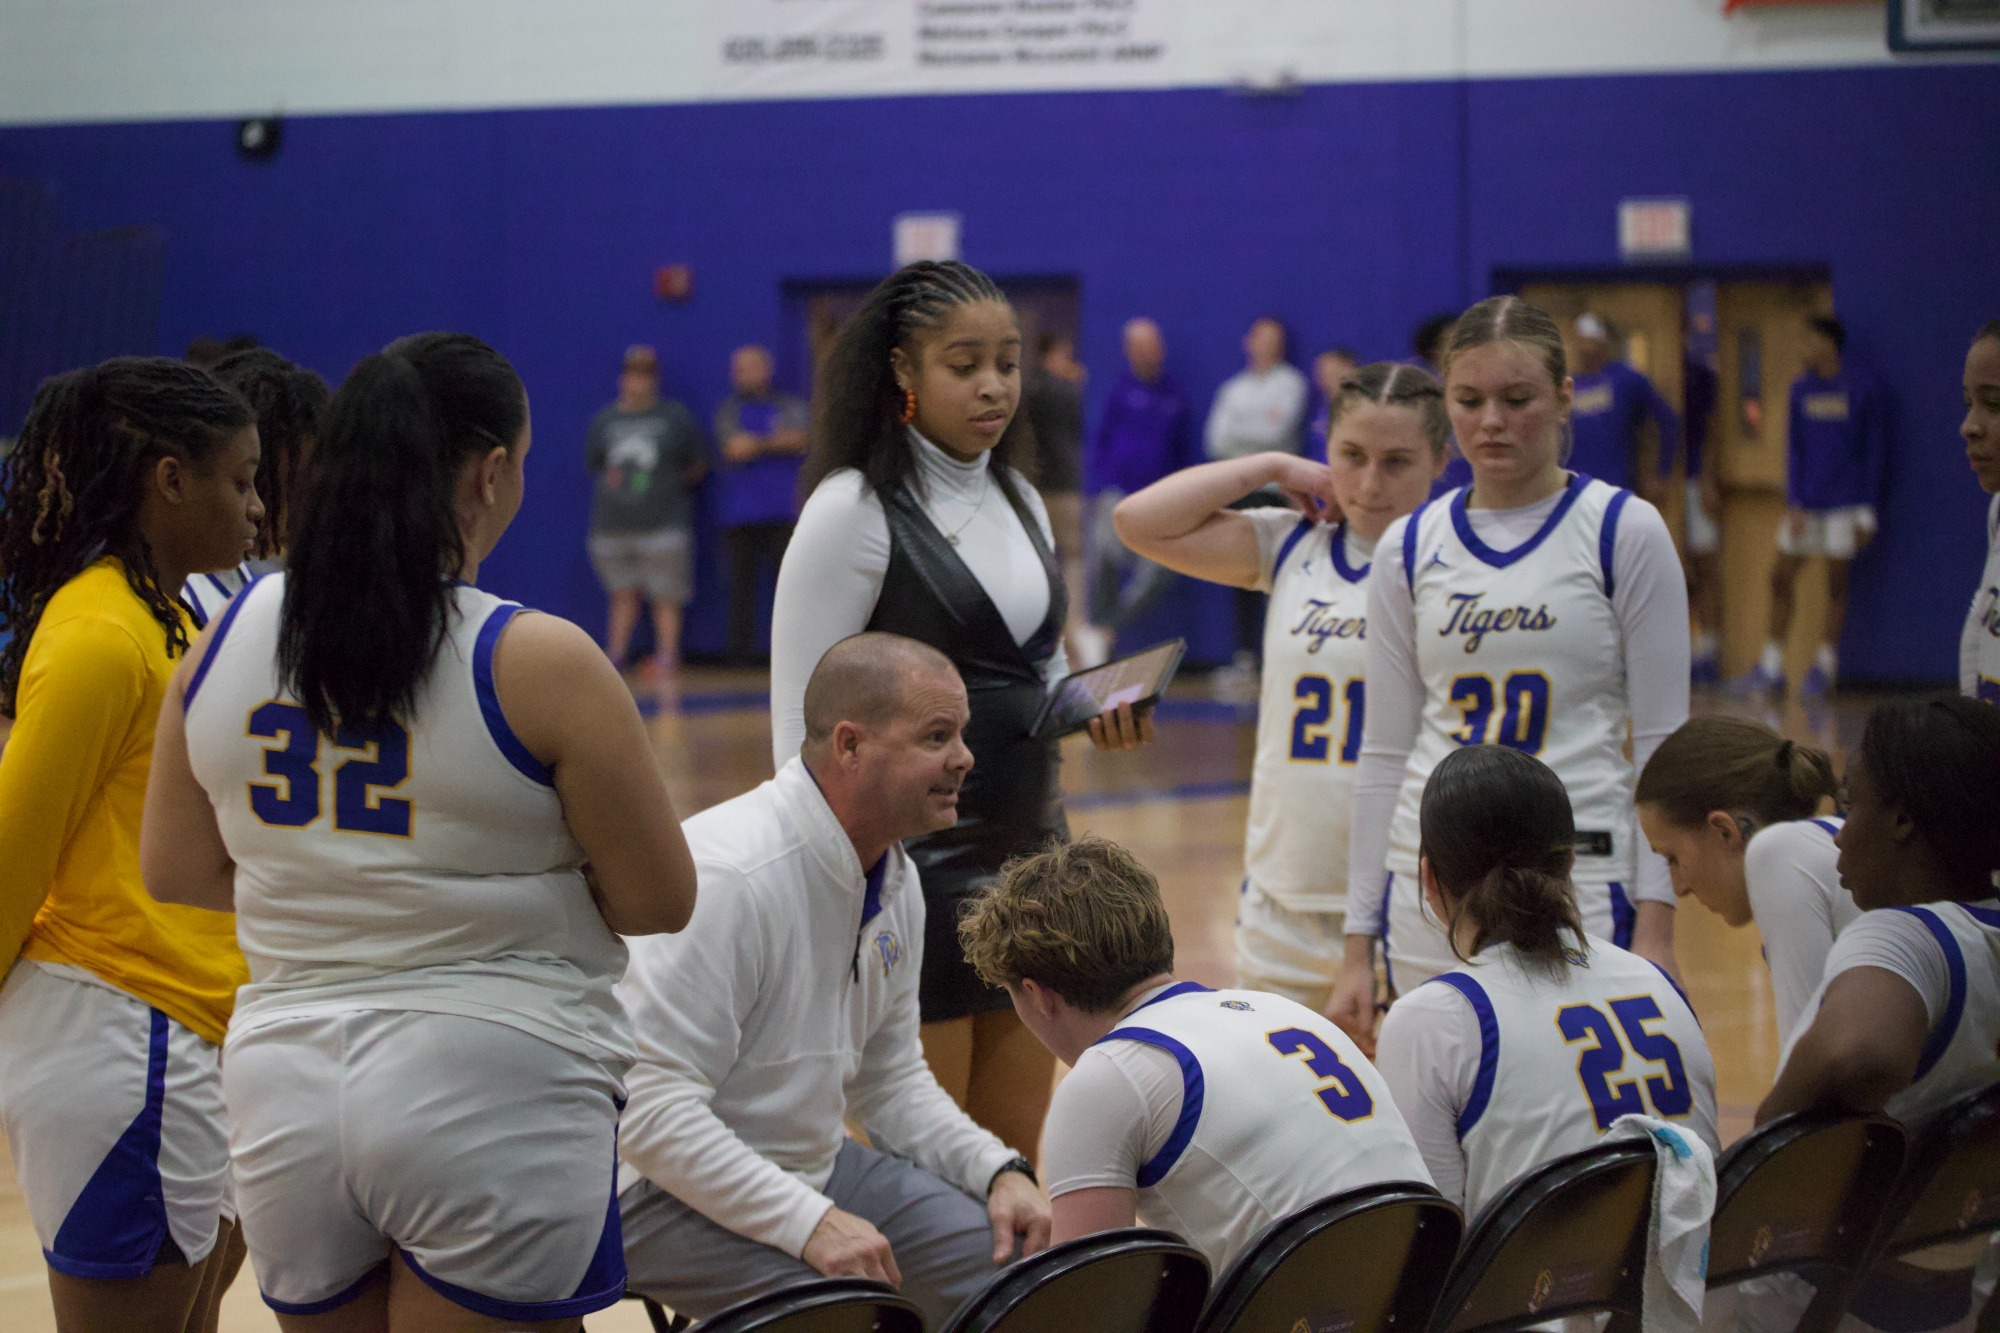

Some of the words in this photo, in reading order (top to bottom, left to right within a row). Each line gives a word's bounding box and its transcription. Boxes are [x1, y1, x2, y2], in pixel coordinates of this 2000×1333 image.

[1290, 599, 1366, 653] Tiger
[1440, 592, 1556, 653] Tigers
[1288, 673, 1366, 766] 21
[1449, 669, 1552, 757] 30
[246, 699, 414, 838] 32
[1265, 1027, 1374, 1124] 3
[1555, 994, 1693, 1133] 25
